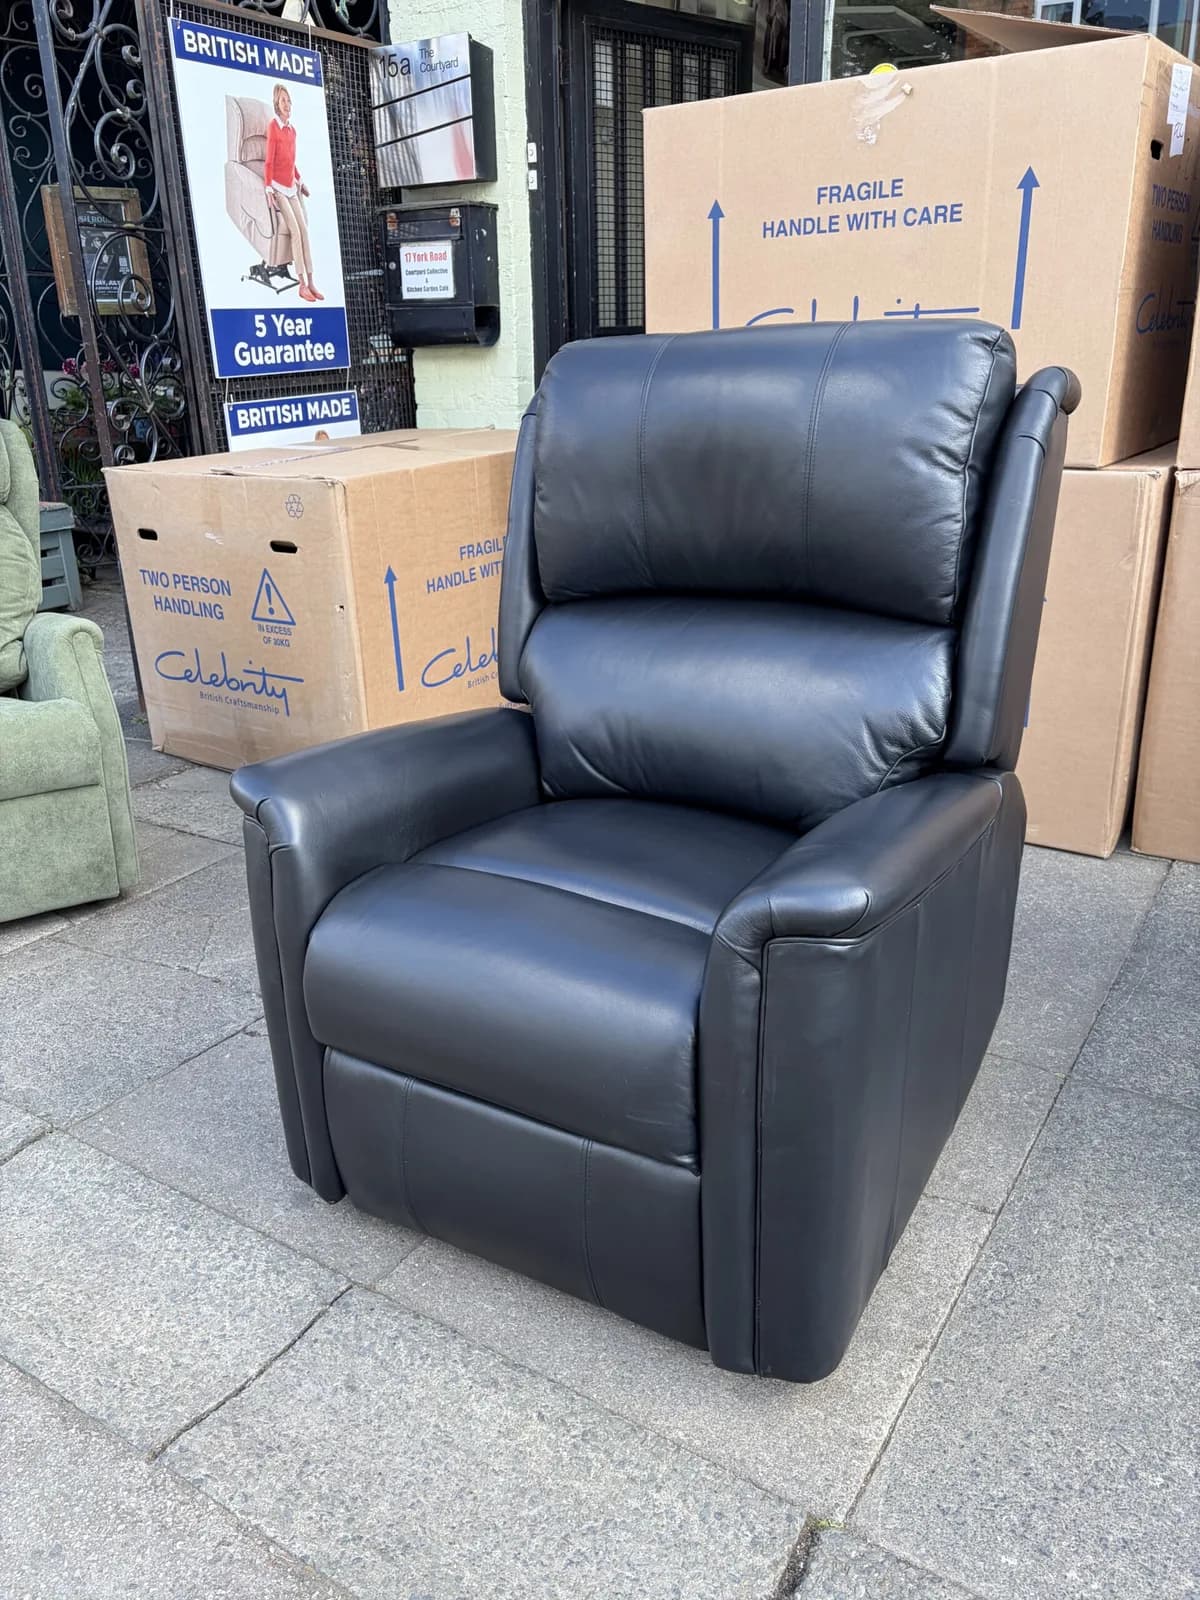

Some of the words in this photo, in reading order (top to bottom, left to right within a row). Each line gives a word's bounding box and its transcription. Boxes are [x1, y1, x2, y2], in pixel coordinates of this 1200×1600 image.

[182, 28, 260, 66] BRITISH
[264, 47, 315, 78] MADE
[379, 53, 411, 78] 15a
[419, 48, 434, 58] The
[420, 56, 459, 73] Courtyard
[817, 178, 904, 205] FRAGILE
[1152, 183, 1167, 209] TWO
[762, 214, 840, 239] HANDLE
[847, 209, 897, 231] WITH
[903, 203, 963, 227] CARE
[1151, 218, 1184, 245] HANDLING
[404, 252, 411, 263] 17
[413, 252, 428, 262] York
[430, 251, 447, 261] Road
[254, 314, 267, 338] 5
[270, 314, 313, 337] Year
[234, 339, 336, 367] Guarantee
[237, 402, 303, 429] BRITISH
[306, 398, 352, 420] MADE
[139, 568, 169, 588] TWO
[172, 573, 232, 597] PERSON
[426, 566, 477, 594] HANDLE
[479, 560, 503, 579] WIT
[153, 595, 224, 620] HANDLING
[262, 635, 272, 645] OF
[265, 624, 293, 637] EXCESS
[154, 647, 305, 717] Celebrity
[467, 676, 490, 689] British
[199, 690, 224, 704] British
[224, 695, 280, 715] Craftsmanship
